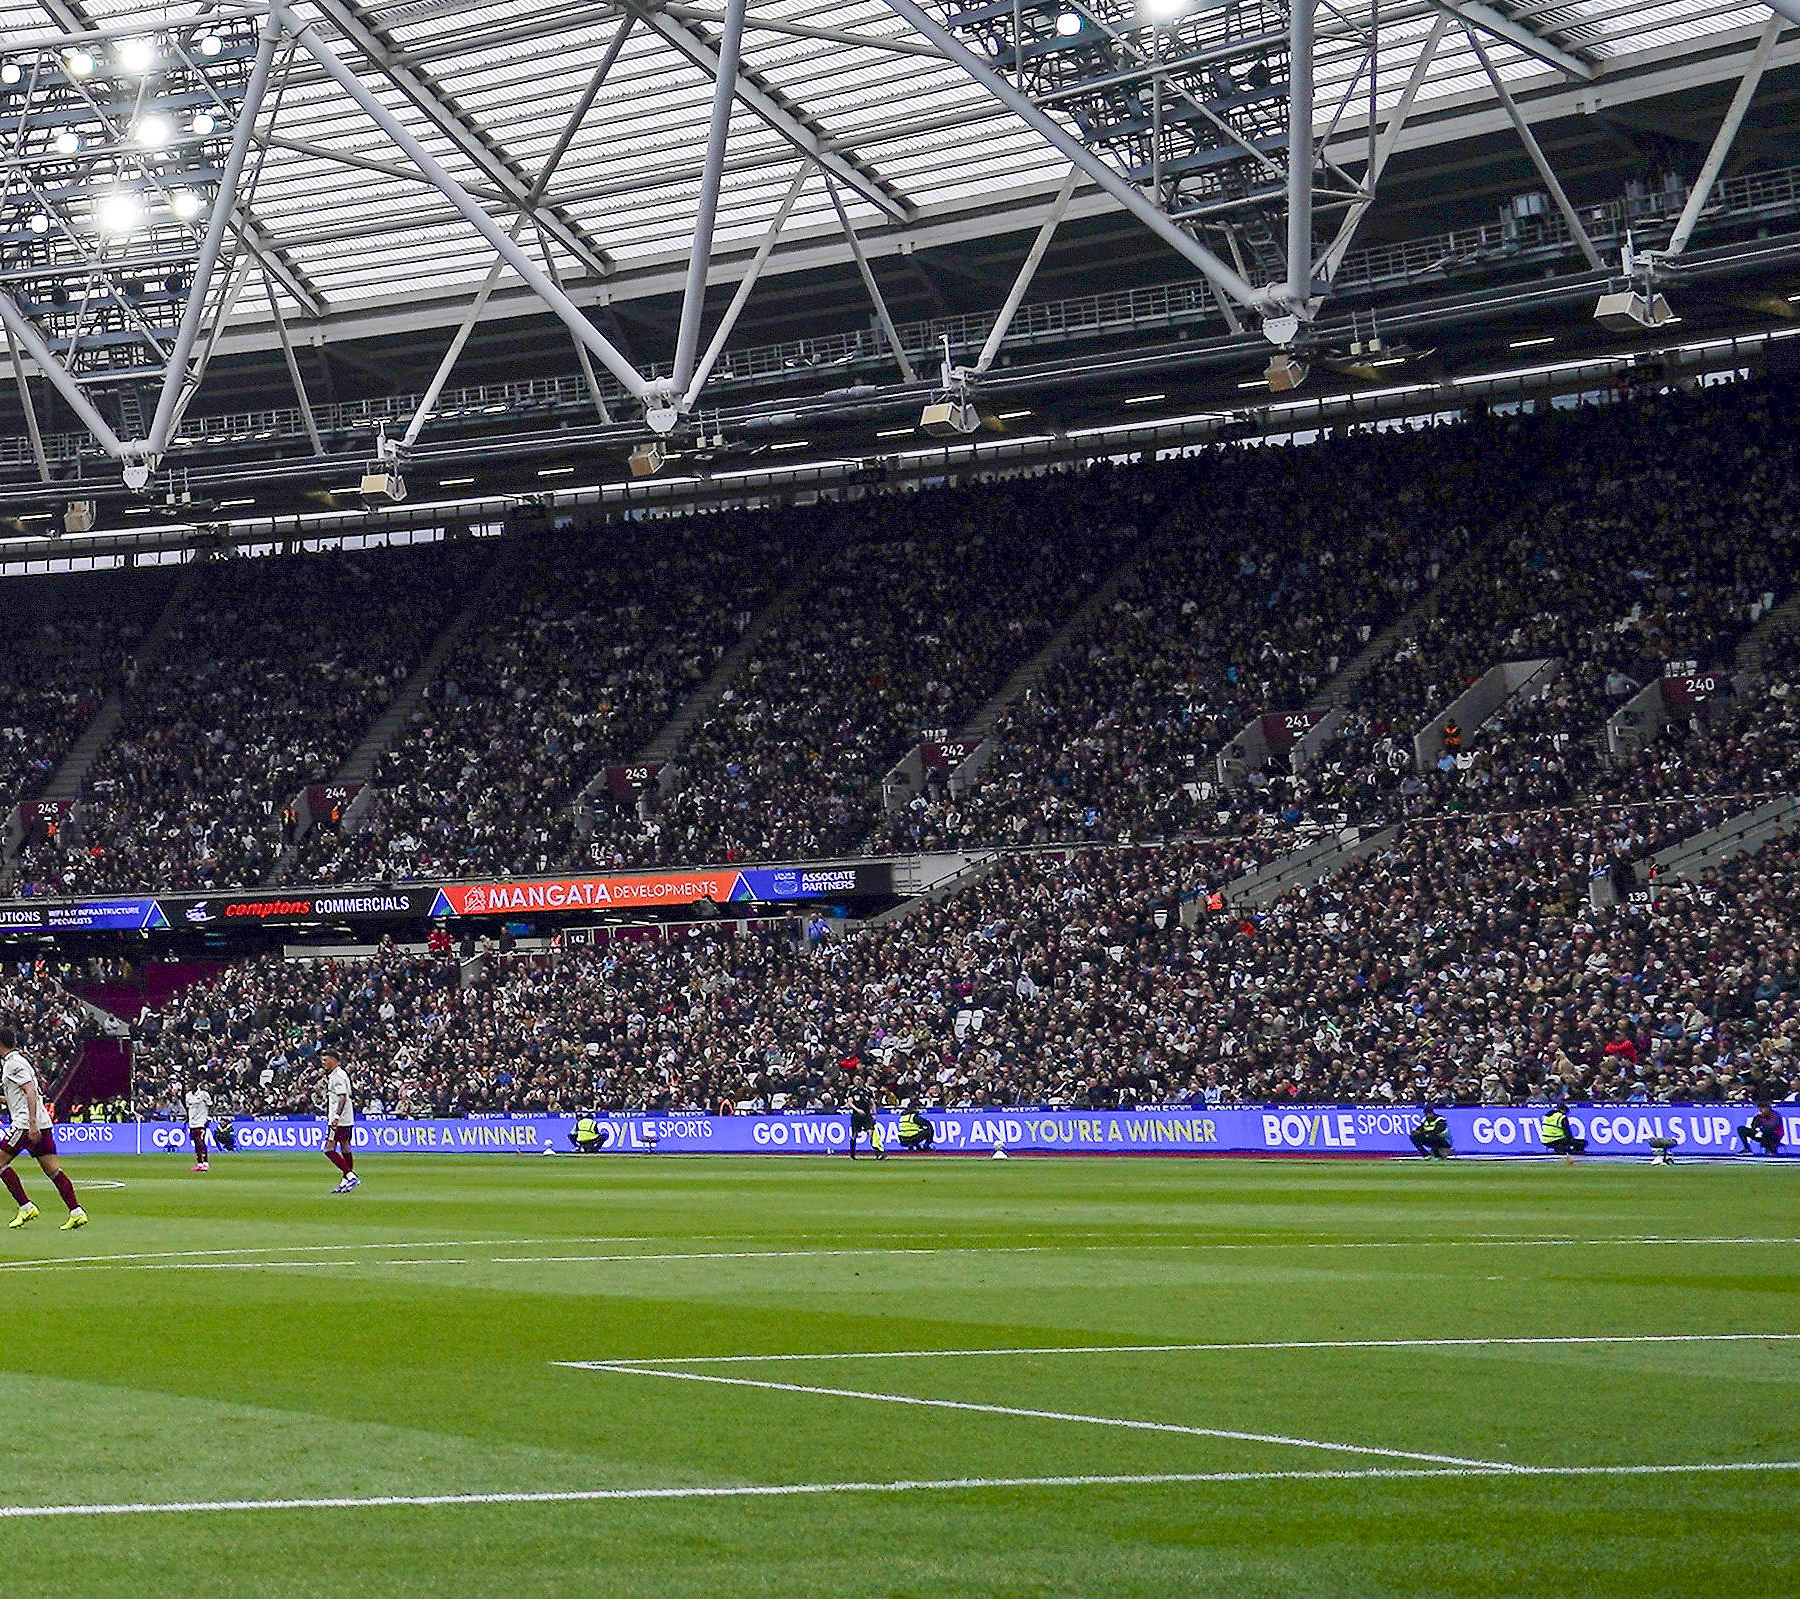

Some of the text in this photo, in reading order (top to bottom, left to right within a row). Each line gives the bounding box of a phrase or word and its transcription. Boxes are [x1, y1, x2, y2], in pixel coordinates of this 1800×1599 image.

[1685, 678, 1715, 692] 240
[1285, 717, 1311, 729] 241
[940, 745, 964, 757] 242
[625, 769, 647, 780] 243
[325, 789, 347, 800] 244
[38, 803, 59, 814] 245
[802, 871, 856, 882] ASSOCIATE
[802, 881, 855, 891] PARTNERS
[488, 881, 718, 909] MANGATA DEVELOPMENTS
[1628, 892, 1648, 902] 139
[225, 896, 409, 918] comptons COMMERCIALS
[846, 933, 859, 942] 14
[59, 1126, 113, 1143] SPORTS
[153, 1128, 186, 1148] GO
[238, 1127, 298, 1146] GOALS
[372, 1127, 437, 1146] YOU'RE
[441, 1127, 453, 1145] A
[458, 1126, 537, 1145] WINNER
[600, 1119, 713, 1148] OYLE SPORTS
[753, 1122, 788, 1144] GO
[791, 1122, 845, 1144] TWO
[970, 1121, 1022, 1144] AND
[1026, 1120, 1102, 1143] YOU'RE
[1108, 1120, 1123, 1142] A
[1126, 1119, 1217, 1143] WINNER
[1262, 1114, 1357, 1147] BOYLE
[1472, 1117, 1516, 1144] GO
[1590, 1116, 1685, 1144] GOALS
[1690, 1116, 1737, 1150] UP,
